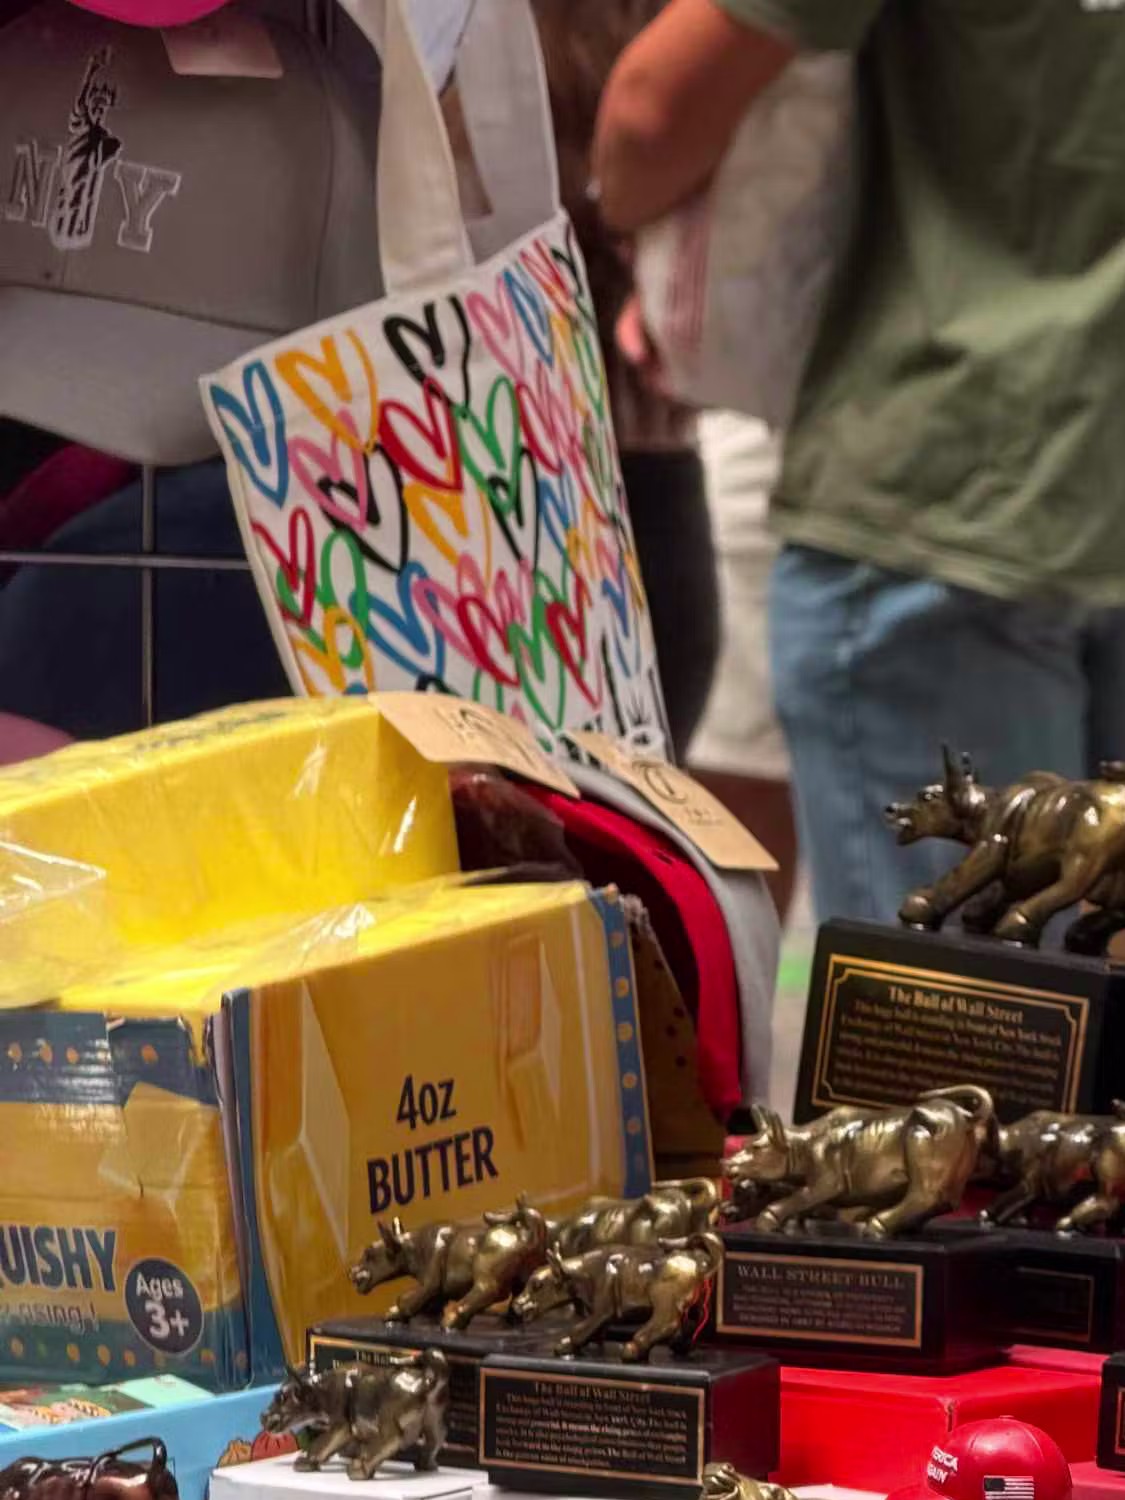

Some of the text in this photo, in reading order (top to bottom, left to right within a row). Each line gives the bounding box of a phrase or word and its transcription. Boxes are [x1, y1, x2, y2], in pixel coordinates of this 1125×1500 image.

[367, 1126, 498, 1215] BUTTER
[0, 1224, 117, 1292] UISHY
[136, 1272, 184, 1300] Ages
[737, 1265, 905, 1290] WALL STREET BULL
[145, 1301, 189, 1339] 3+
